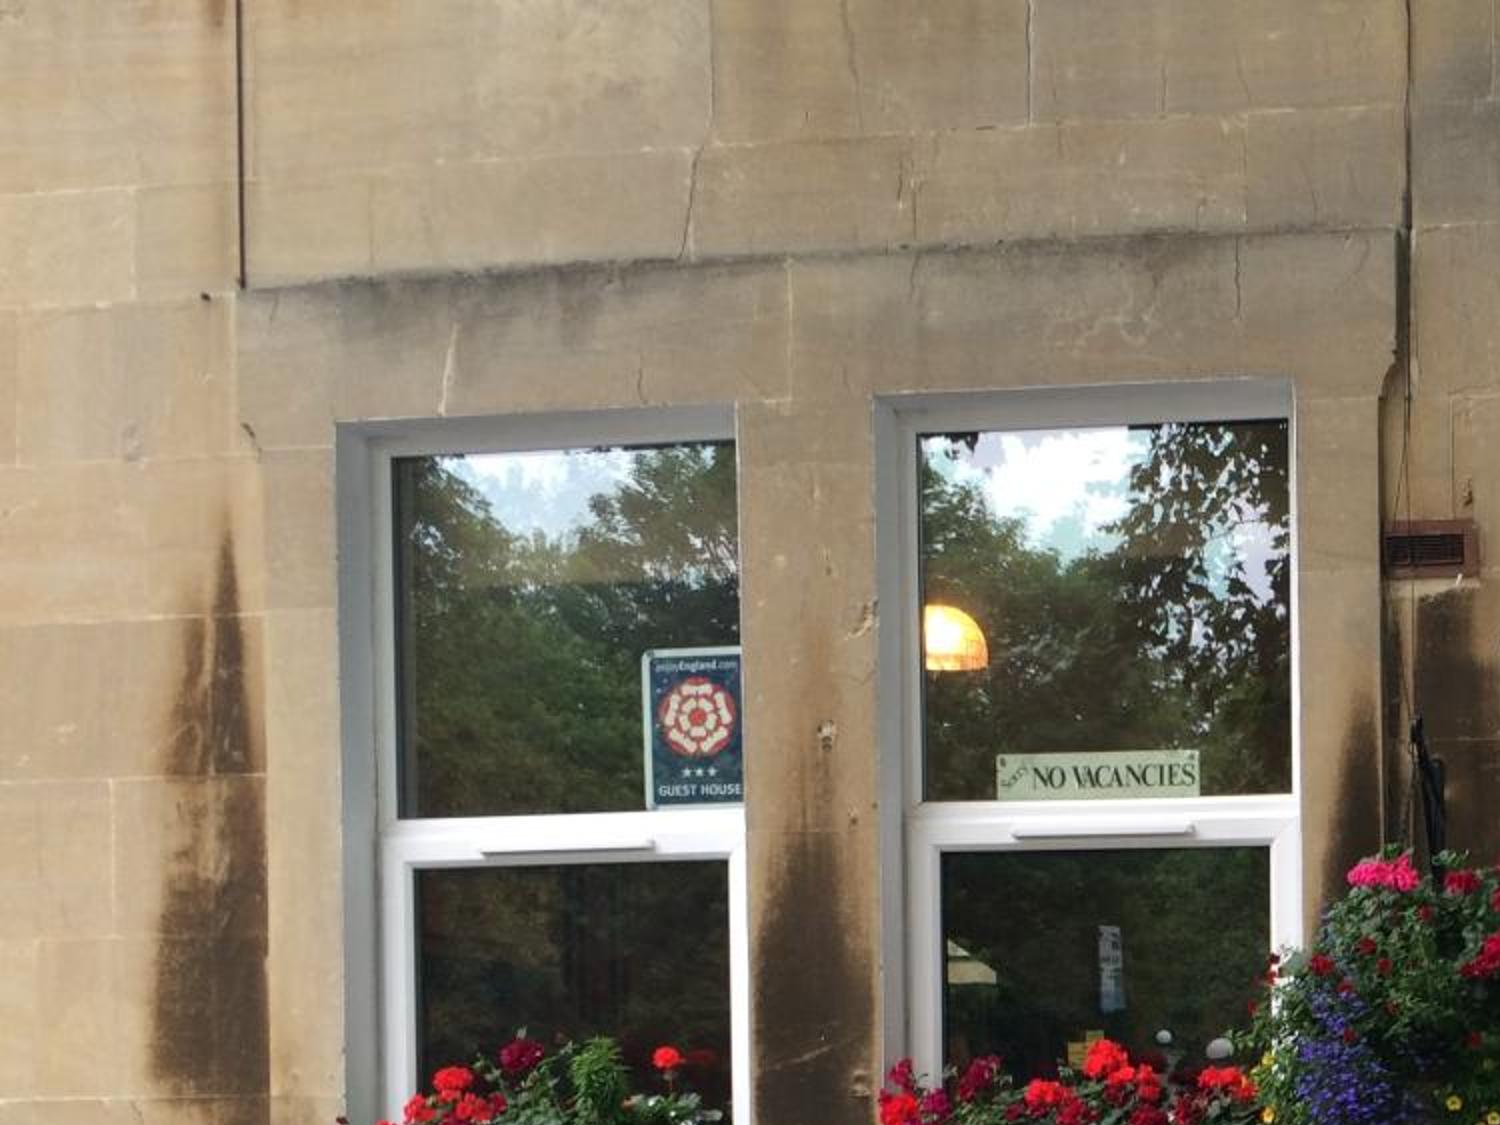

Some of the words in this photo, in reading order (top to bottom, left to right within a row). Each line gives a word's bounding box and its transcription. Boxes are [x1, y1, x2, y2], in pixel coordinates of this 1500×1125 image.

[1032, 765, 1067, 790] NO
[1072, 762, 1196, 790] VACANCIES
[658, 784, 697, 797] GUEST
[701, 783, 742, 796] HOUSE
